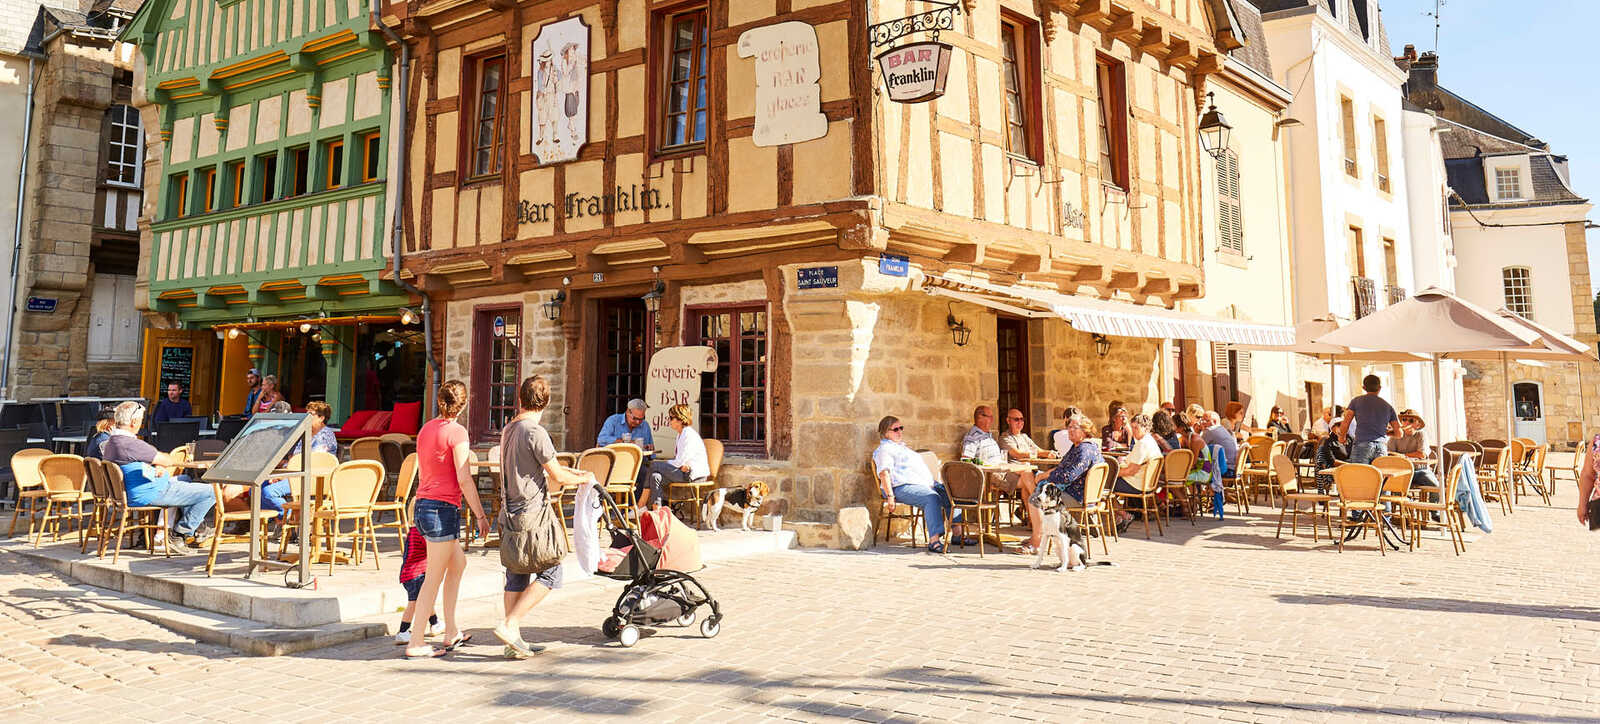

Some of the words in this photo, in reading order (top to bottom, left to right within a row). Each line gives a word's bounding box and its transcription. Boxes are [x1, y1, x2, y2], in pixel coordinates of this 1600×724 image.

[888, 49, 932, 68] BAR
[772, 67, 806, 88] BAR
[517, 199, 555, 225] Bar
[808, 269, 824, 277] PLACE
[813, 277, 837, 285] SAUVEUR
[661, 390, 690, 405] BAR
[652, 412, 671, 432] gla
